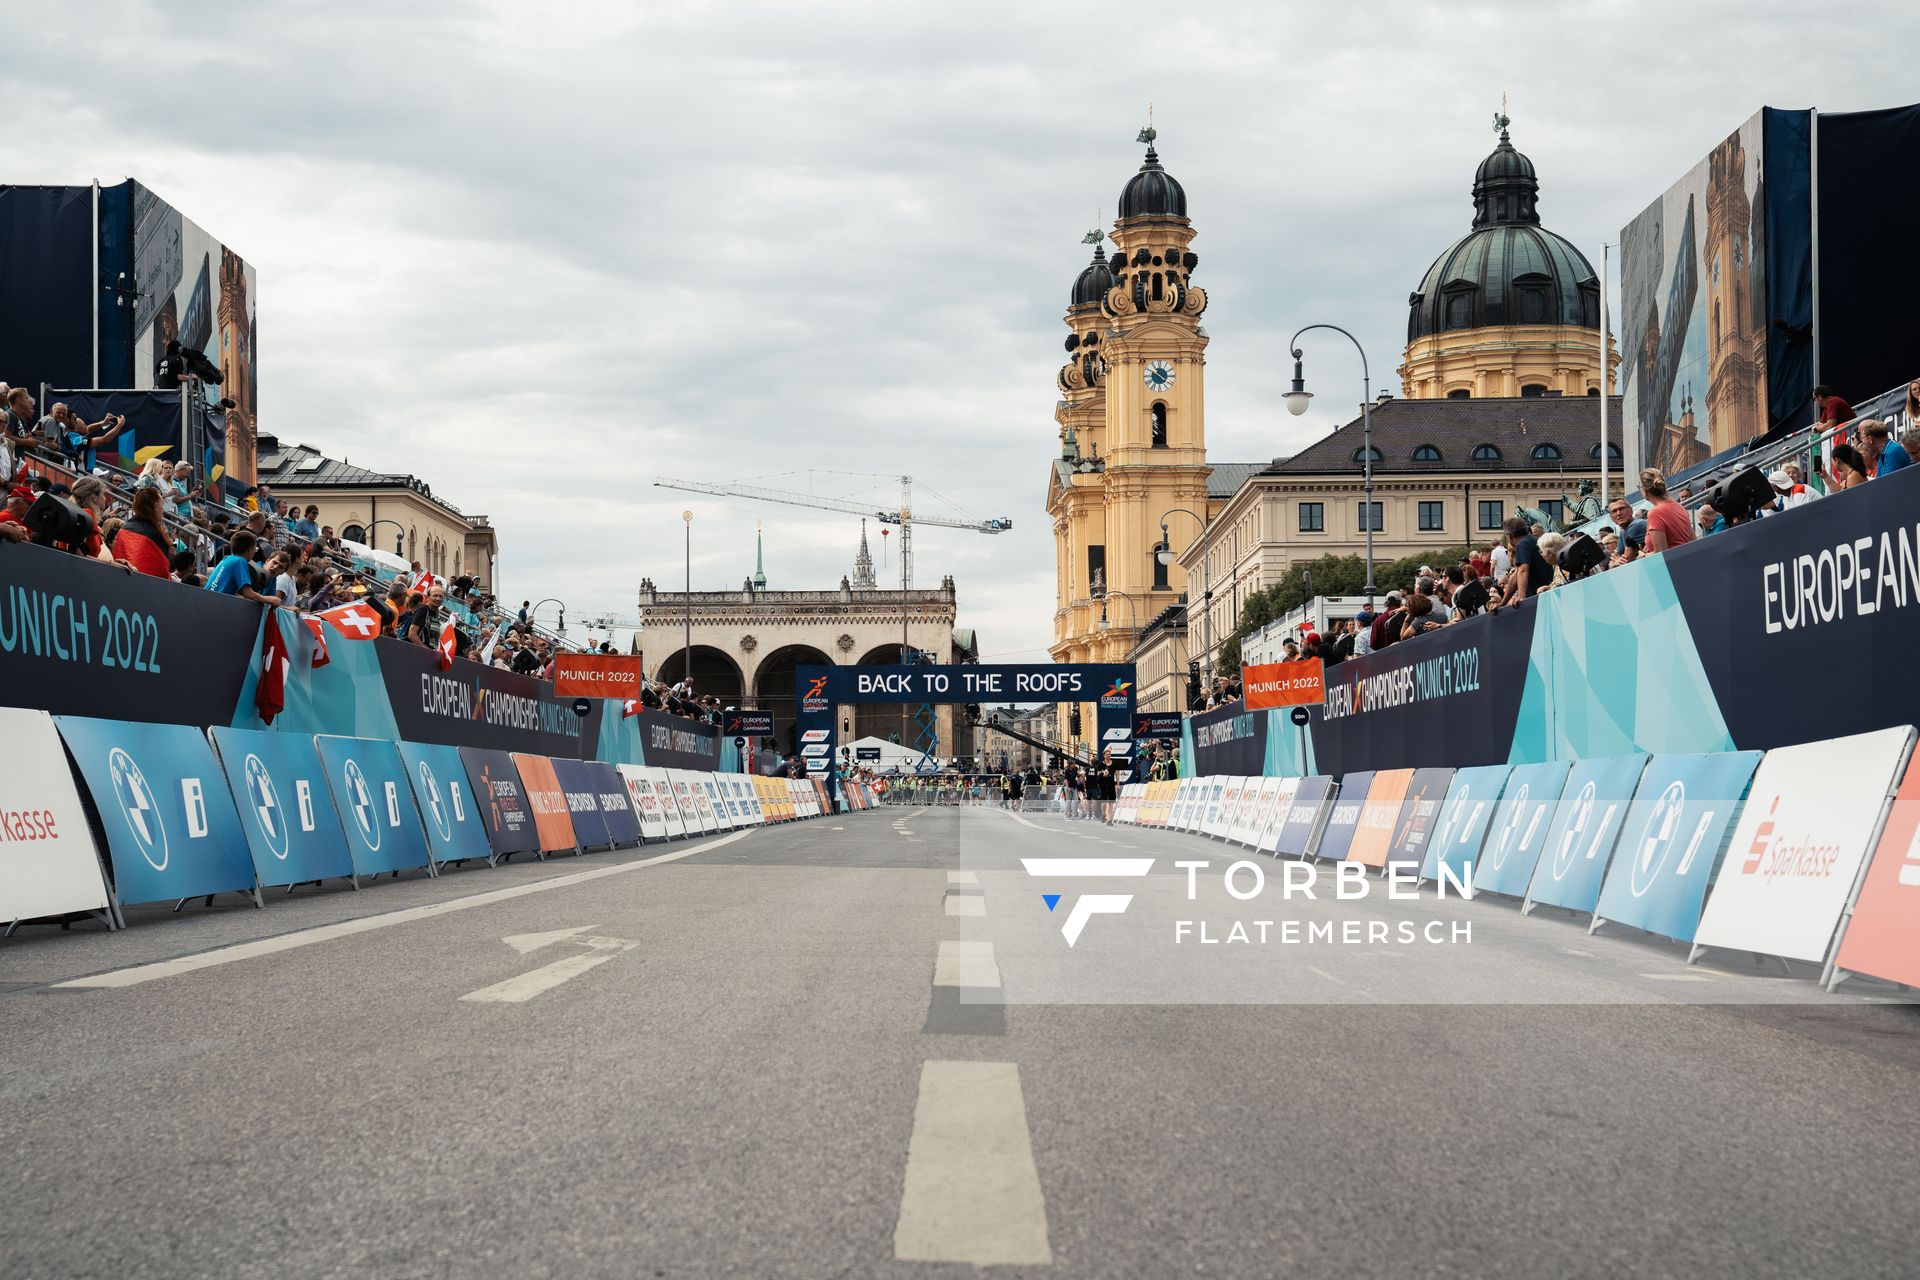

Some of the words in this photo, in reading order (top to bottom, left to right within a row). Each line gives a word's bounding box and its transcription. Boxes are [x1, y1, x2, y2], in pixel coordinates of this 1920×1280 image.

[1764, 523, 1920, 634] EUROPEAN
[98, 605, 161, 673] 2022
[560, 670, 605, 681] MUNICH
[608, 672, 635, 683] 2022
[858, 674, 912, 693] BACK
[923, 674, 949, 693] TO
[962, 673, 1002, 692] THE
[1016, 673, 1082, 692] ROOFS
[1248, 680, 1290, 694] MUNICH
[1293, 677, 1320, 689] 2022
[1362, 665, 1414, 713] CHAMPIONSHIPS
[1415, 653, 1451, 701] MUNICH
[1453, 646, 1480, 693] 2022
[421, 673, 471, 720] EUROPEAN
[485, 689, 539, 731] CHAMPIONSHIPS
[539, 701, 564, 735] MUNICH
[565, 707, 579, 737] 2022
[0, 807, 58, 842] kasse
[1763, 834, 1841, 886] Sparkasse
